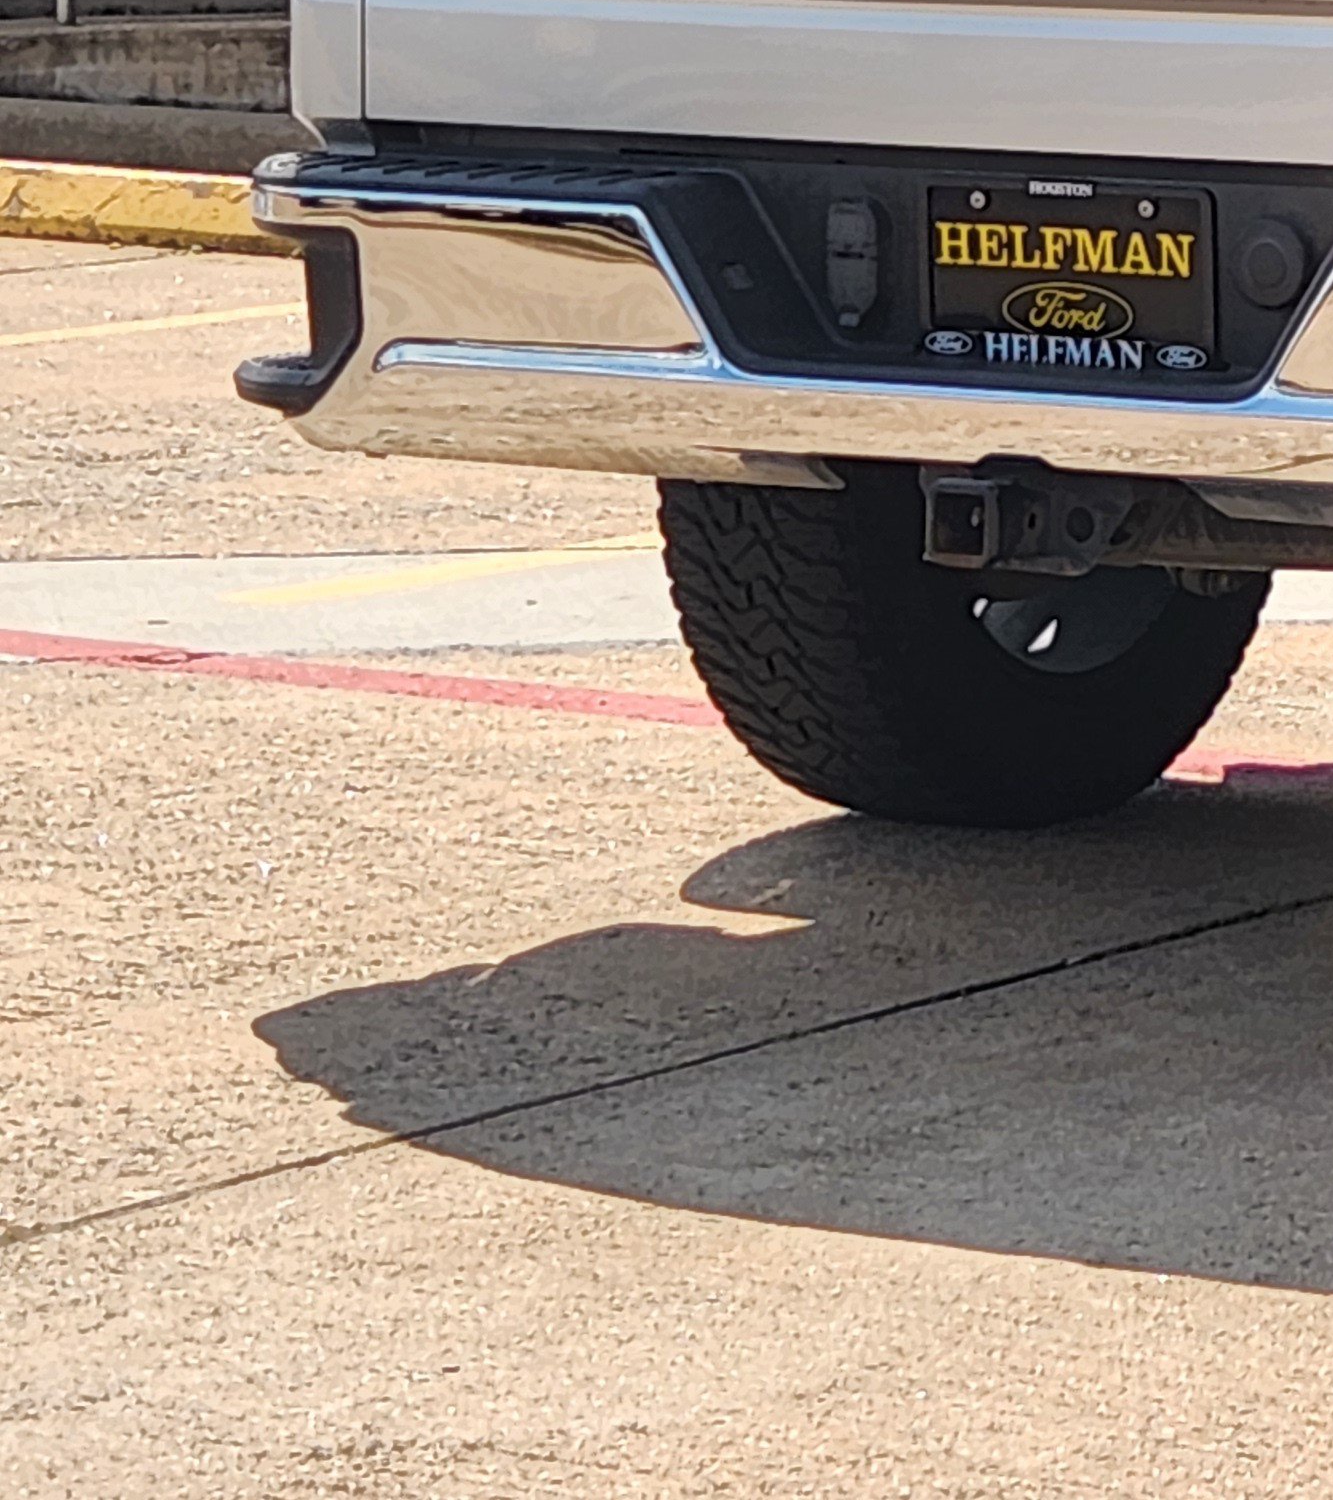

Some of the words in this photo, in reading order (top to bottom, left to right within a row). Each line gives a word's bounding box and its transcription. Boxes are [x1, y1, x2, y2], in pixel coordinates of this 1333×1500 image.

[1027, 180, 1093, 197] HOUSTON
[934, 220, 1196, 279] HELFMAN
[1028, 288, 1107, 332] Ford
[983, 331, 1145, 371] HELFMAN
